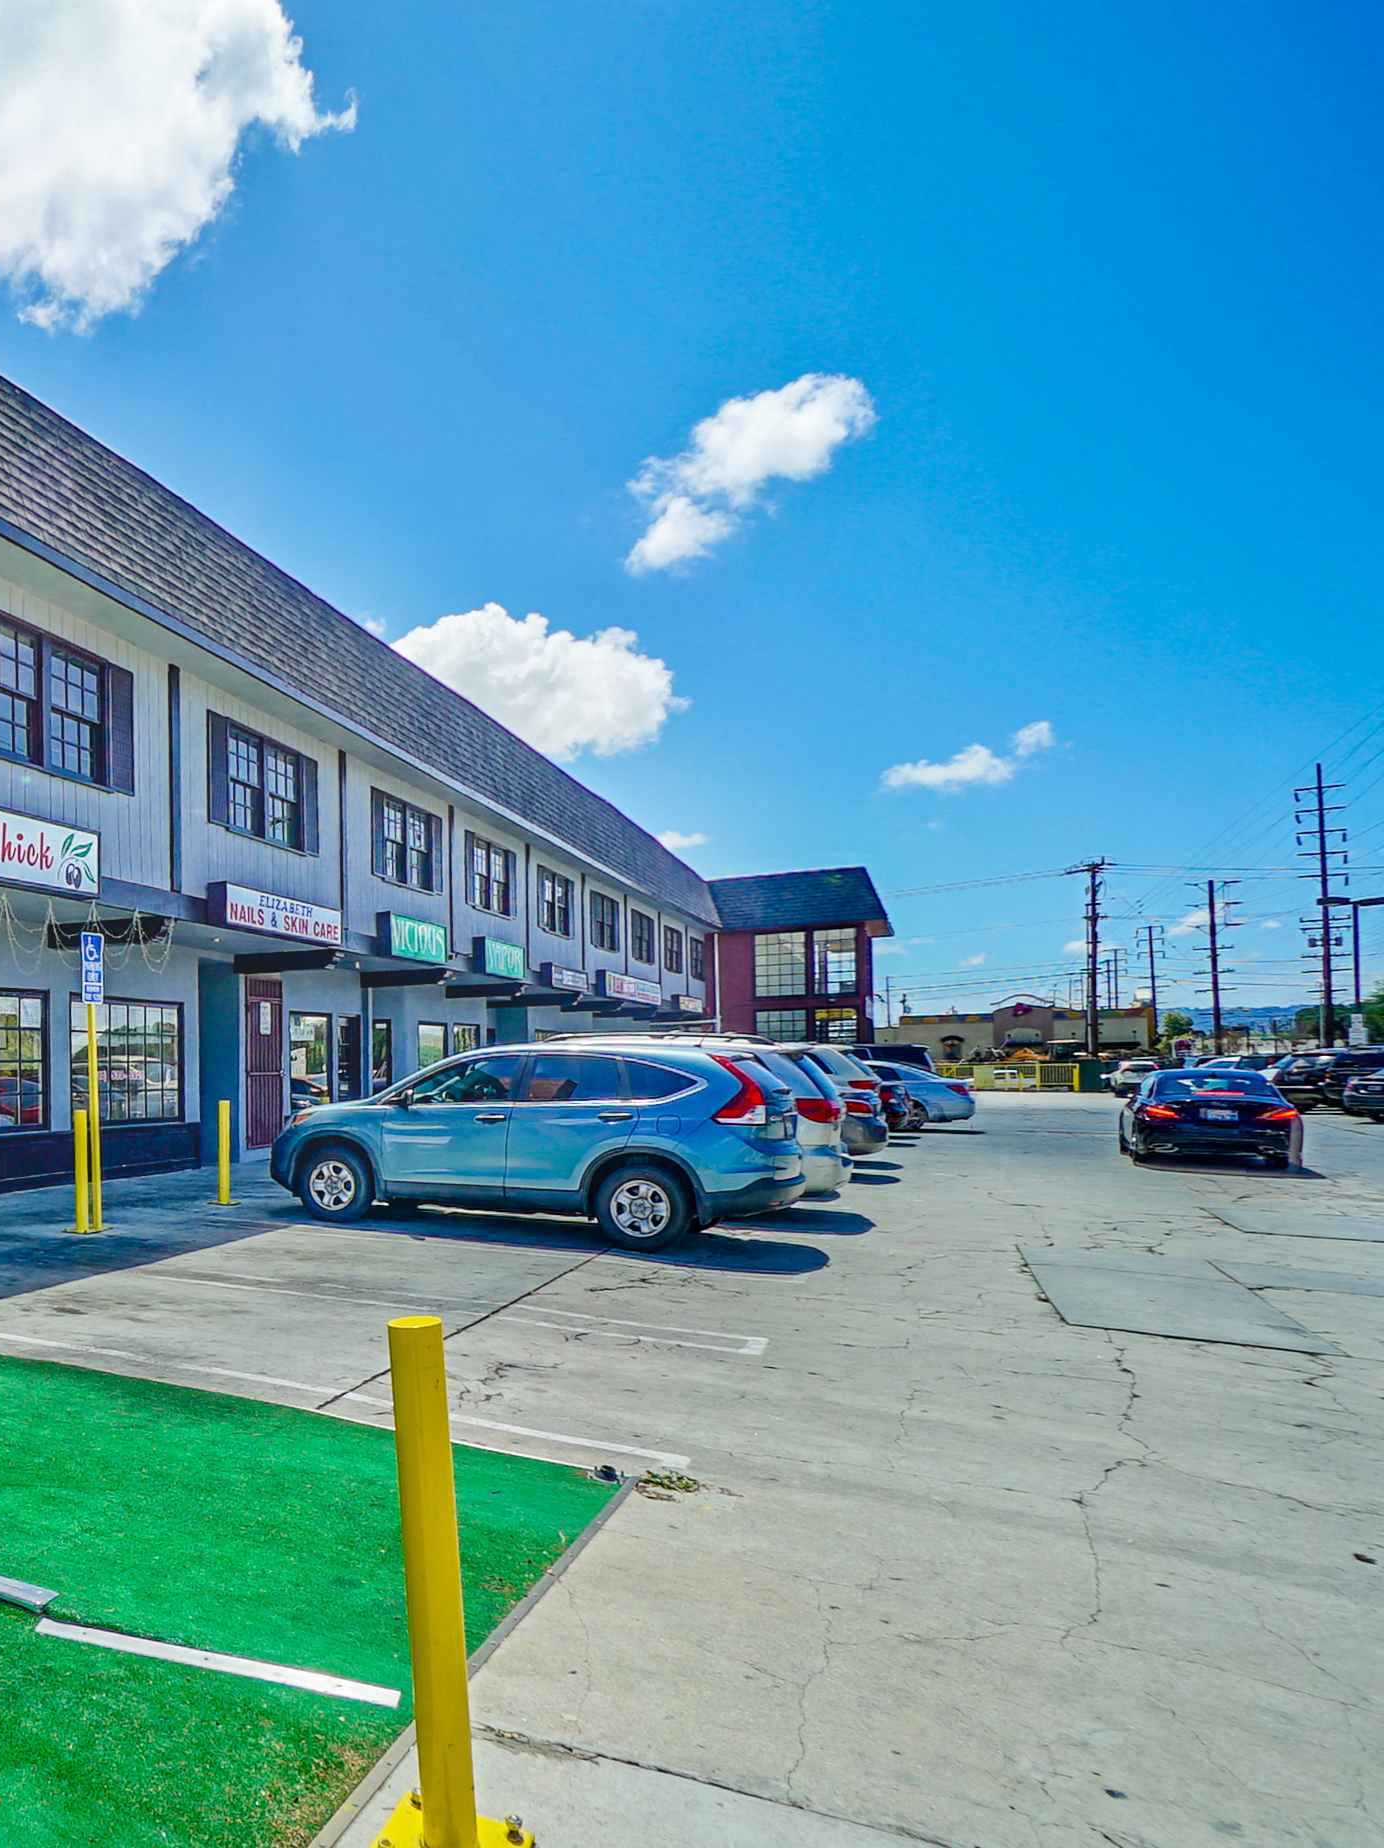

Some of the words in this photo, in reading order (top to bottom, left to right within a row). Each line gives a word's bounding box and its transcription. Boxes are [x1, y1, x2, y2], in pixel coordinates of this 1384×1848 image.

[229, 902, 265, 926] NAILS
[270, 912, 279, 929] &
[283, 914, 309, 935] SKIN
[313, 919, 339, 941] CARE
[258, 895, 313, 918] ELIZABETH
